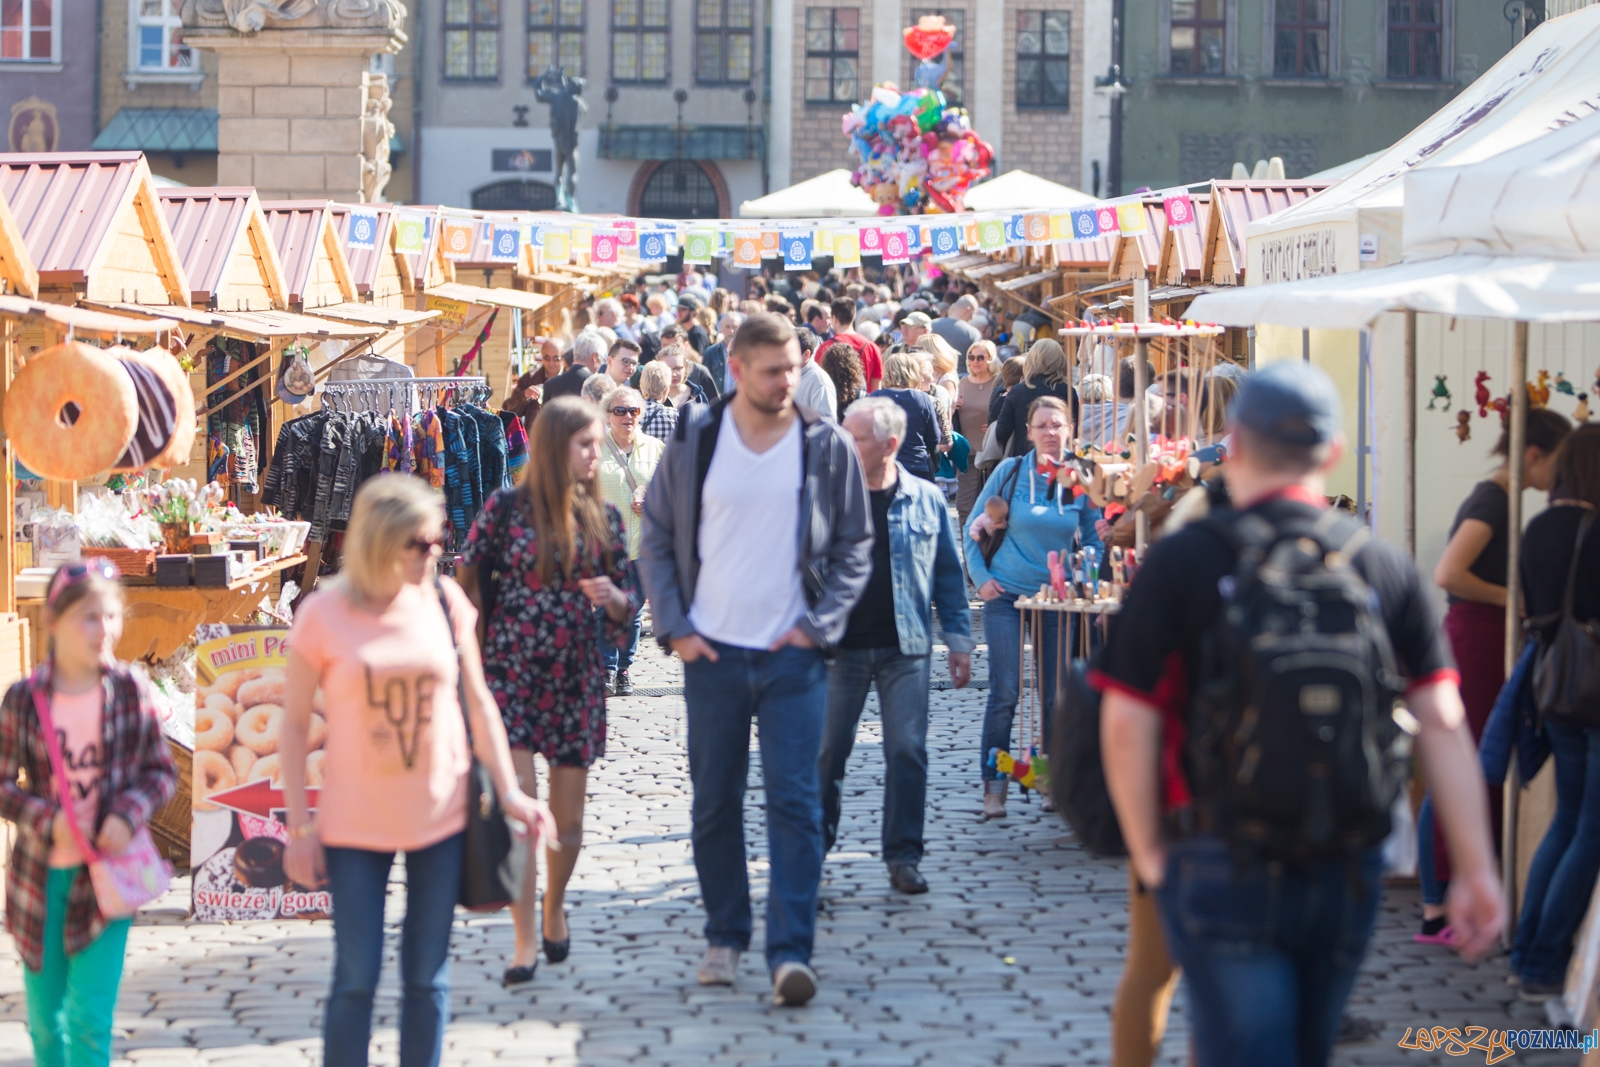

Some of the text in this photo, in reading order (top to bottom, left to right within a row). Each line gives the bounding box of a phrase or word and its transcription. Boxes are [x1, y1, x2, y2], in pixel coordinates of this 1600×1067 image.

[210, 637, 257, 667] mini
[270, 890, 277, 909] i
[282, 892, 334, 914] gorą
